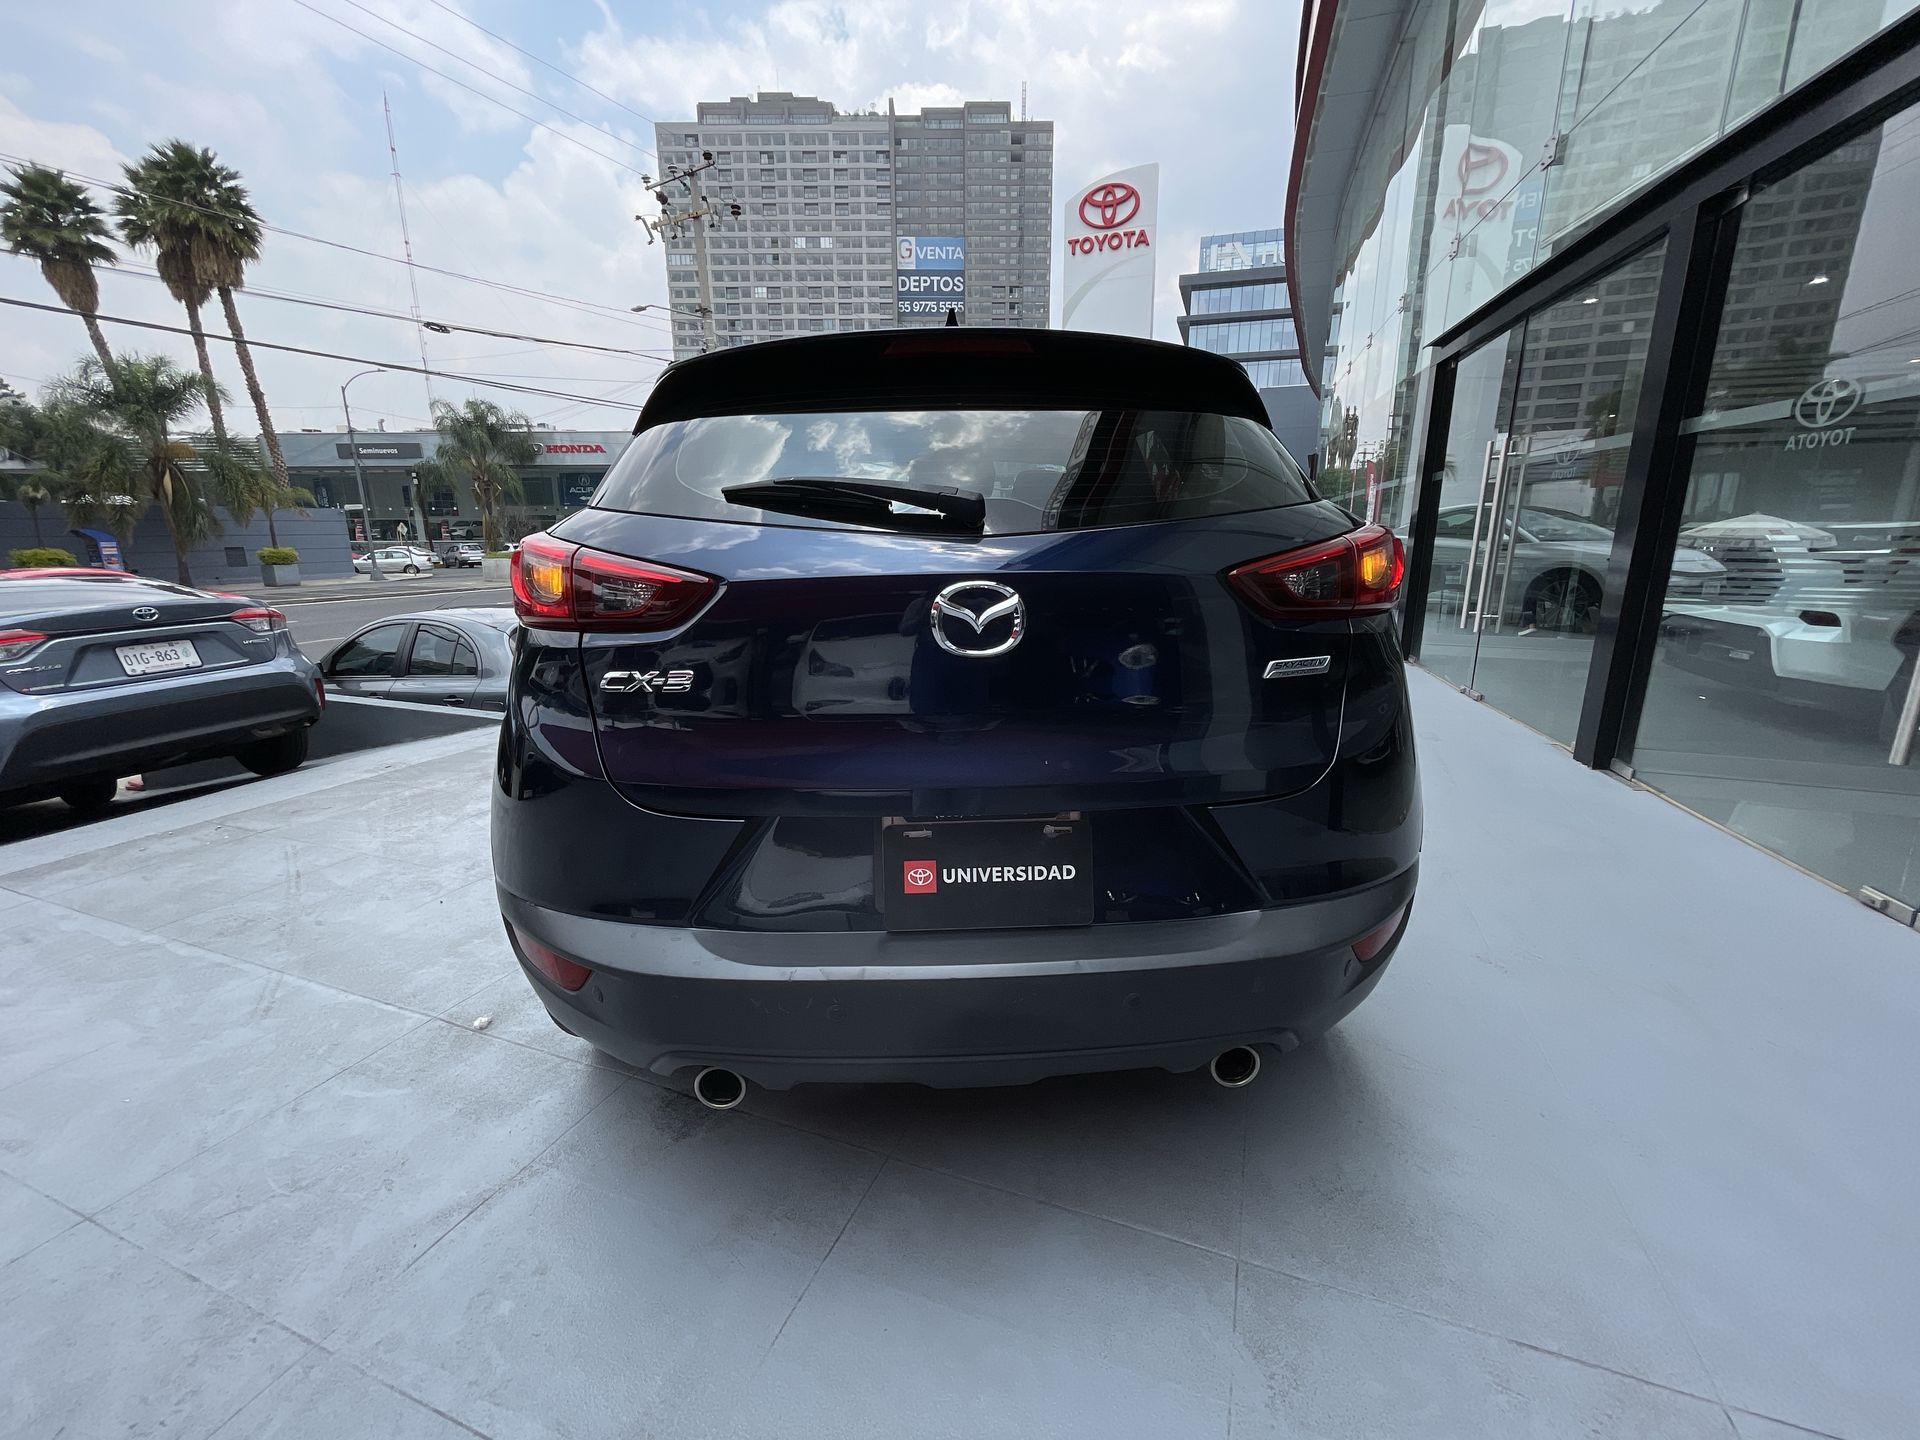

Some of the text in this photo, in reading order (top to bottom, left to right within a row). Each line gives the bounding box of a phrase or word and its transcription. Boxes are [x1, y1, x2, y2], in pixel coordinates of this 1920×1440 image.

[1068, 229, 1150, 256] TOYOTA
[916, 246, 964, 260] VENTA
[898, 276, 964, 292] DEPTOS
[898, 301, 911, 313] 55
[912, 301, 937, 313] 9775
[359, 447, 398, 455] Seminuevos
[545, 444, 606, 453] HONDA
[569, 486, 596, 494] ACUR
[600, 670, 694, 692] CX-3
[942, 864, 1076, 884] UNIVERSIDAD
